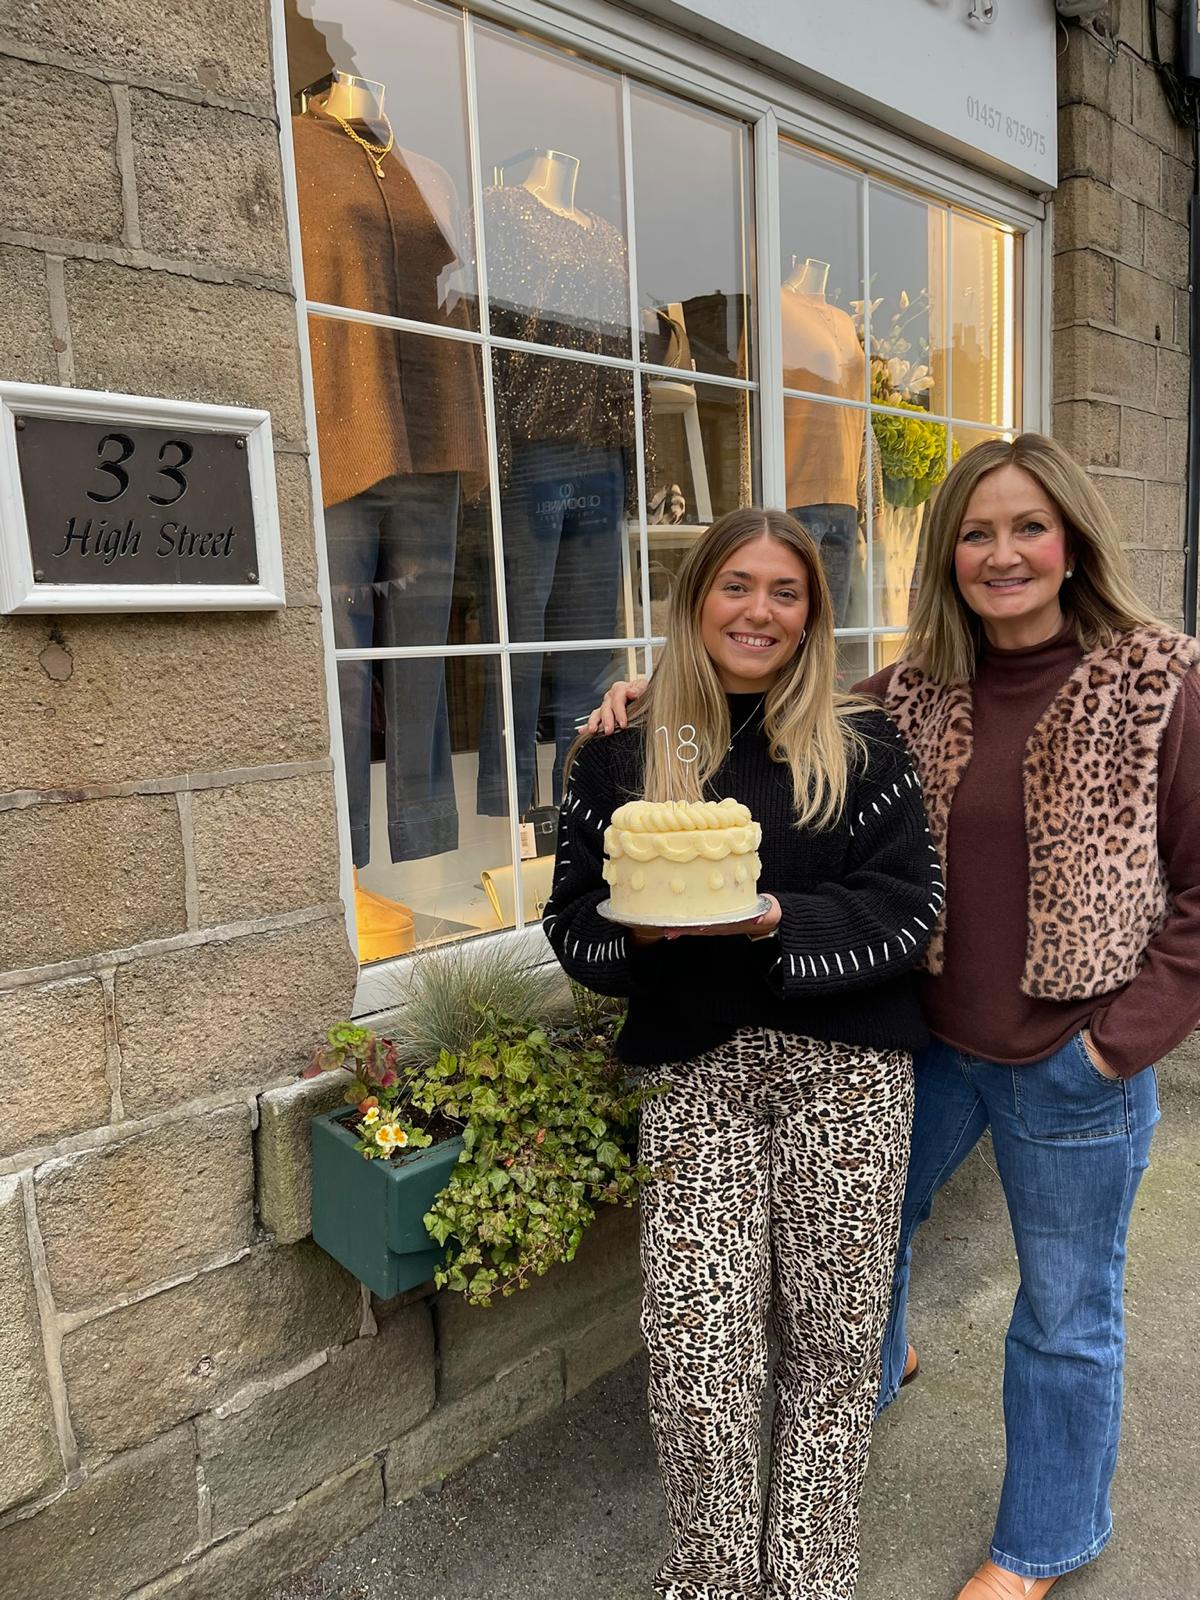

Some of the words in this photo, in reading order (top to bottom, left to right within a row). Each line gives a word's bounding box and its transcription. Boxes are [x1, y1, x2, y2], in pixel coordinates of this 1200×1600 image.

[966, 95, 1002, 133] 01457
[1006, 116, 1046, 156] 875975
[86, 433, 194, 507] 33
[52, 516, 142, 566] High
[156, 522, 236, 558] Street
[655, 724, 699, 764] 18
